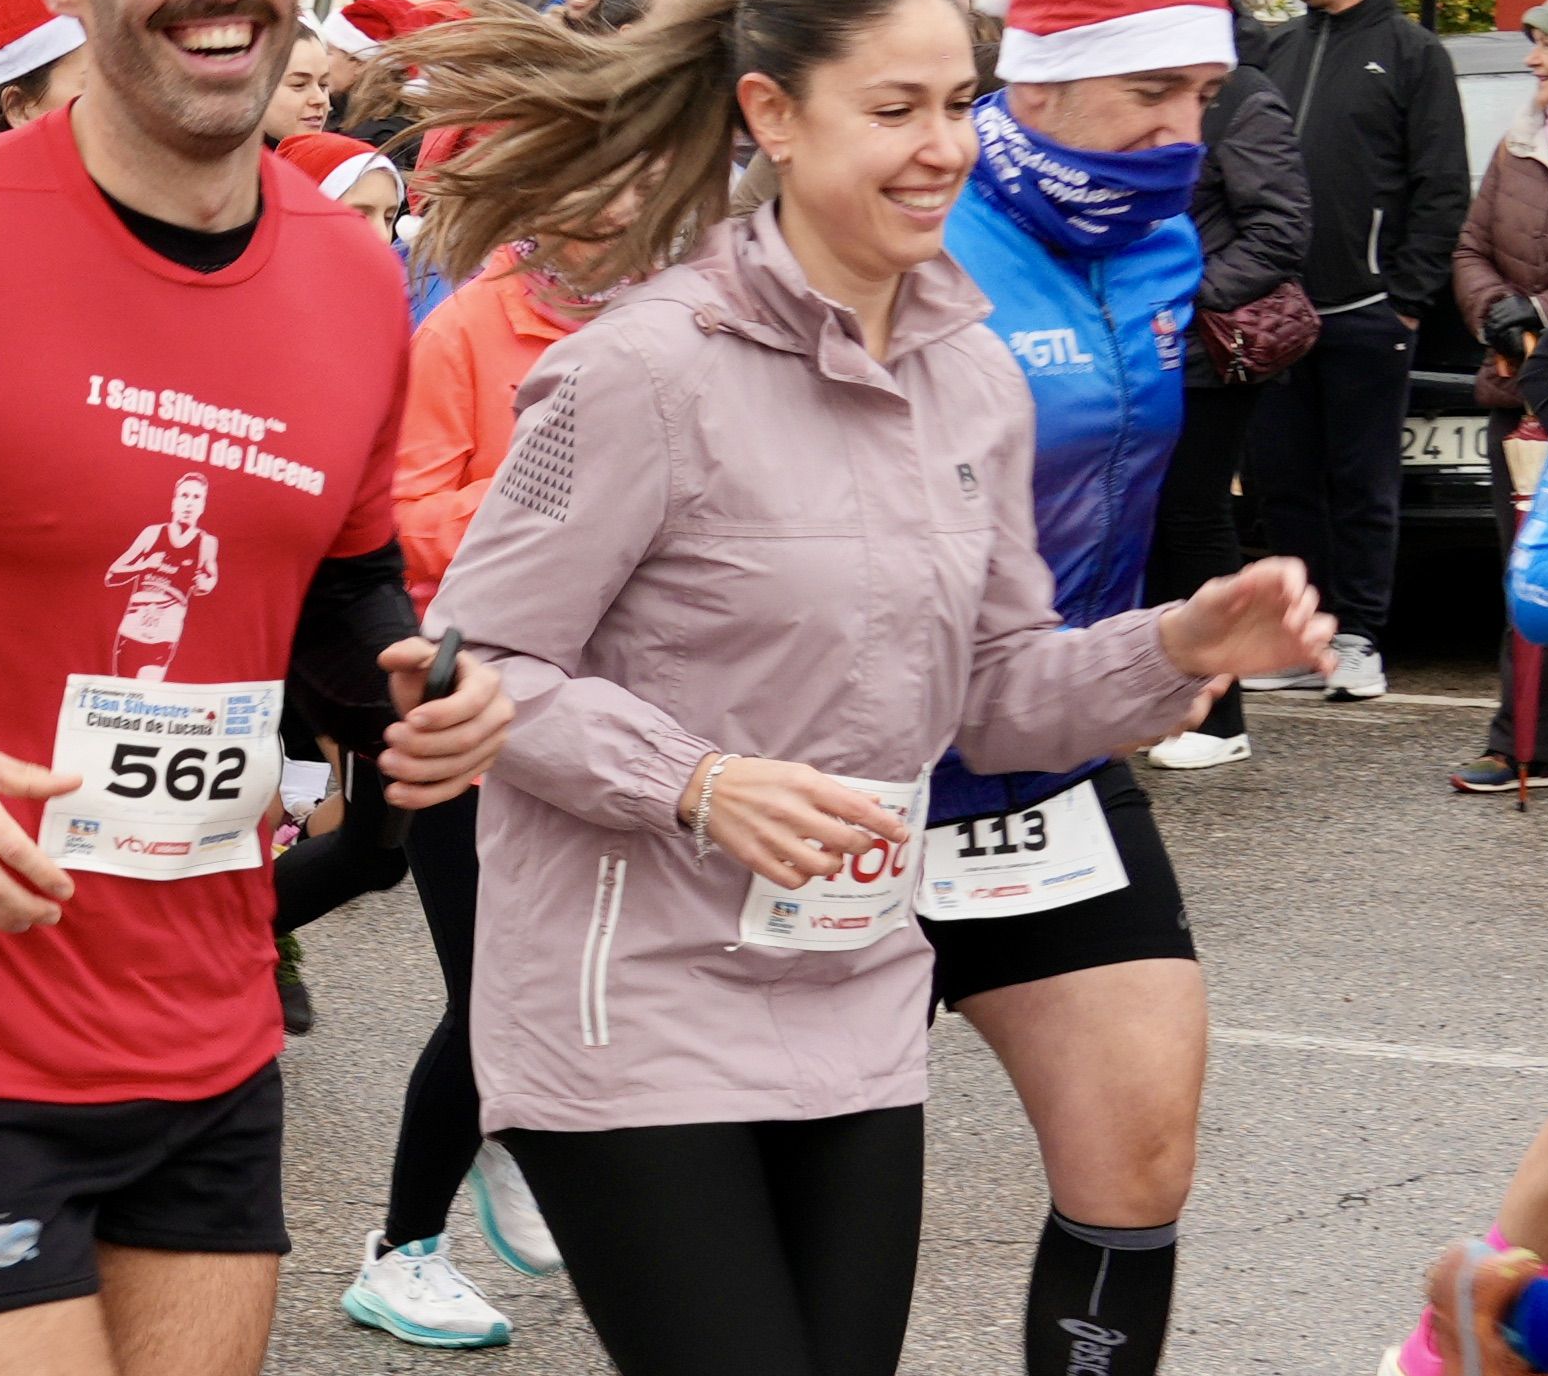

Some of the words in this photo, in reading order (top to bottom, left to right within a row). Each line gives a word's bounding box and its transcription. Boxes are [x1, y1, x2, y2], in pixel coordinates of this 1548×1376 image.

[1026, 328, 1094, 367] GTL
[87, 375, 104, 406] I
[106, 378, 156, 417] San
[158, 389, 265, 443] Silvestre
[121, 416, 210, 463] Ciudad
[210, 438, 243, 471] de
[244, 445, 326, 497] Lucena
[87, 711, 141, 731] Ciudad
[145, 718, 164, 734] de
[90, 695, 119, 713] San
[123, 698, 190, 719] Silvestre
[105, 743, 247, 802] 562
[956, 810, 1049, 859] 113
